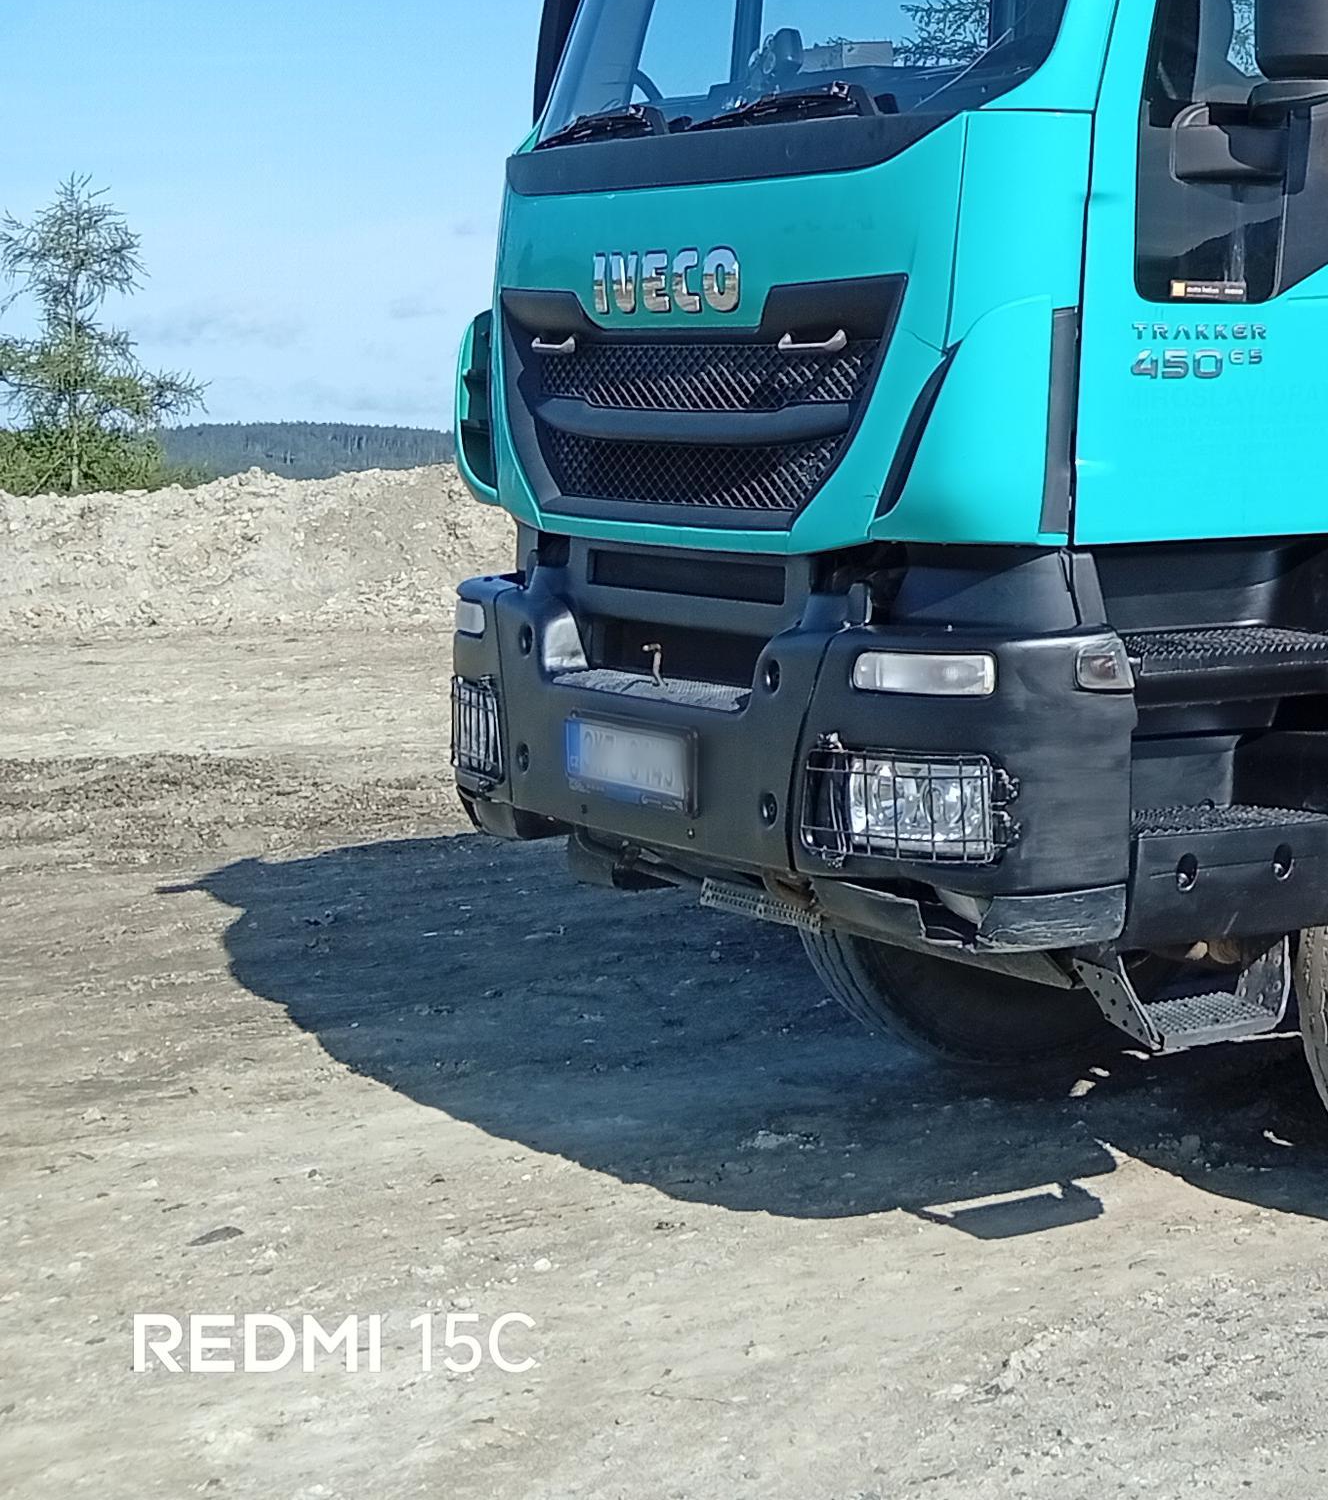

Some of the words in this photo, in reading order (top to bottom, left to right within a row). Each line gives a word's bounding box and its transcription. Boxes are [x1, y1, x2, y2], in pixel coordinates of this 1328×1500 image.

[592, 245, 740, 314] IVECO
[1132, 323, 1267, 340] TRAKKER
[1131, 348, 1224, 379] 450
